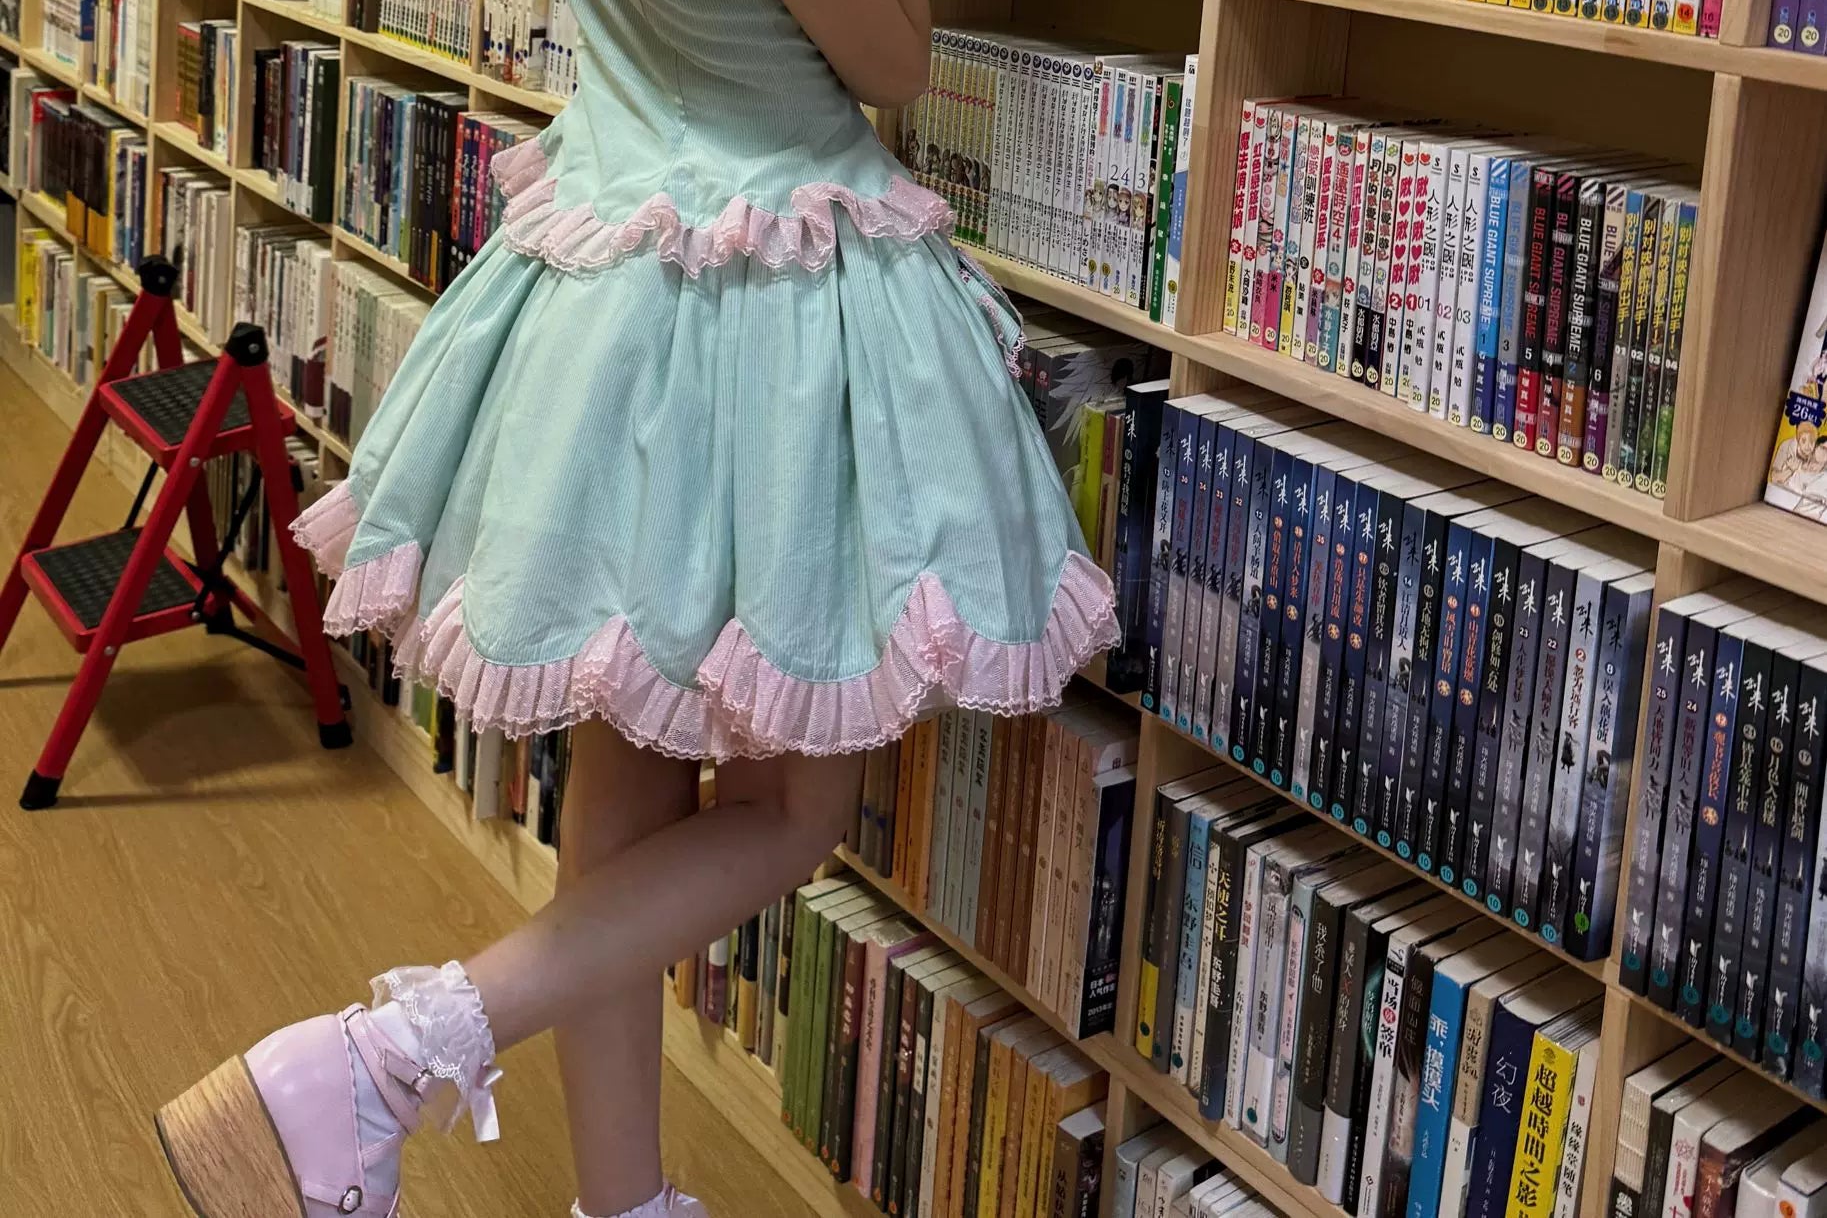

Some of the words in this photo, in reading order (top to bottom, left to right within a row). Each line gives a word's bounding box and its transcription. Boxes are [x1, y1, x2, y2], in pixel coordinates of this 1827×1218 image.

[1488, 195, 1501, 222] BLUE
[1533, 206, 1546, 238] BLUE
[1578, 218, 1592, 245] BLUE
[1484, 225, 1498, 267] GIANT
[1530, 241, 1543, 280] GIANT
[1551, 247, 1565, 286] GIANT
[1574, 246, 1590, 289] GIANT
[1417, 298, 1432, 312] 01
[1437, 302, 1452, 318] 02
[1456, 308, 1471, 324] 03
[1546, 287, 1563, 344] SUPREME
[1503, 339, 1510, 352] 3
[1525, 348, 1533, 361] 5
[1615, 345, 1627, 355] 01
[1631, 348, 1644, 360] 02
[1648, 353, 1661, 365] 03
[1595, 369, 1602, 381] 6
[1665, 358, 1678, 369] 04
[1188, 841, 1202, 870] 信
[1215, 869, 1232, 942] 天使之耳
[1491, 1055, 1518, 1114] 幻夜
